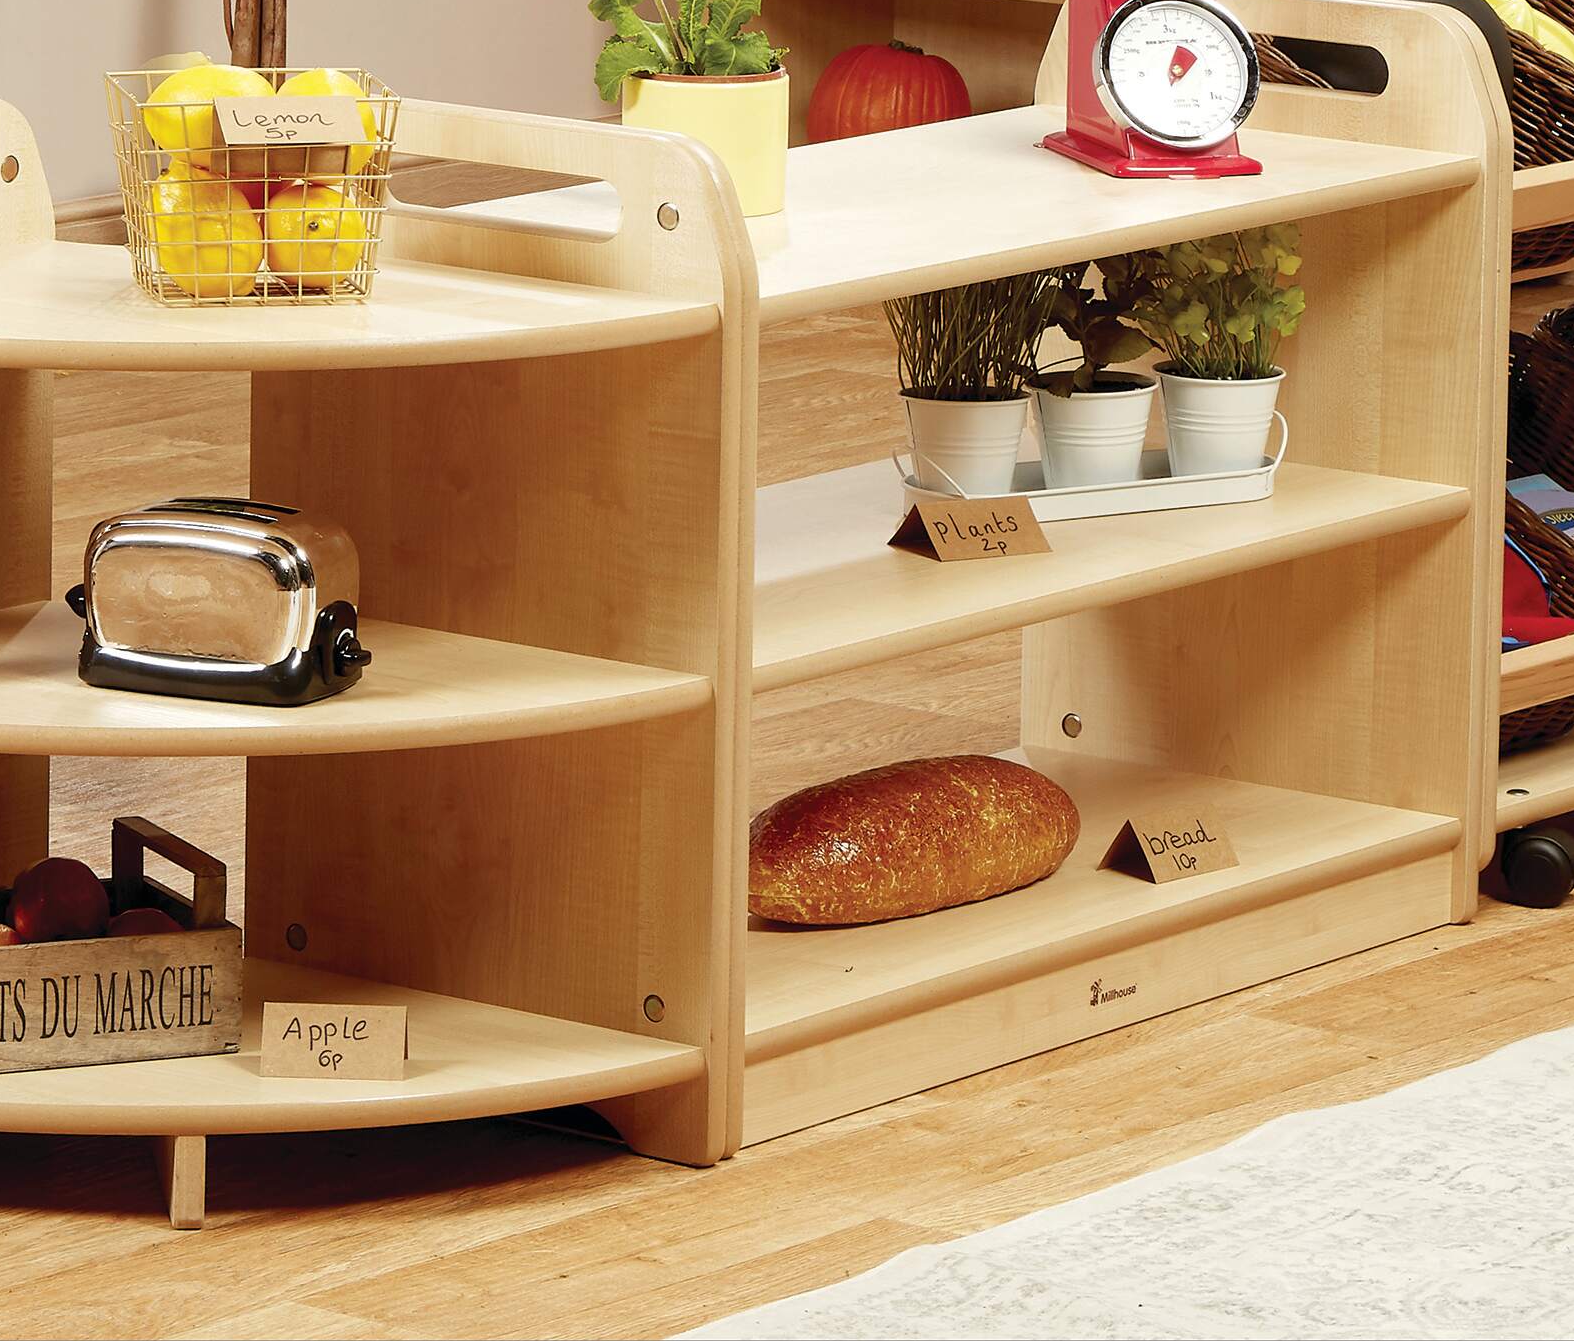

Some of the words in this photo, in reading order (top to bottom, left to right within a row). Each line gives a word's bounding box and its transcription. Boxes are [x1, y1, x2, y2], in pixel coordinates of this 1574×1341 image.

[232, 110, 335, 127] Lemon
[265, 127, 298, 140] 5p
[981, 538, 1007, 554] 2p
[1142, 819, 1217, 855] bread
[1172, 853, 1197, 871] 10p
[40, 974, 81, 1039] DU
[93, 964, 214, 1036] MARCHE
[1100, 985, 1136, 1004] Millhouse
[282, 1017, 369, 1051] Apple
[318, 1049, 343, 1071] 6p
